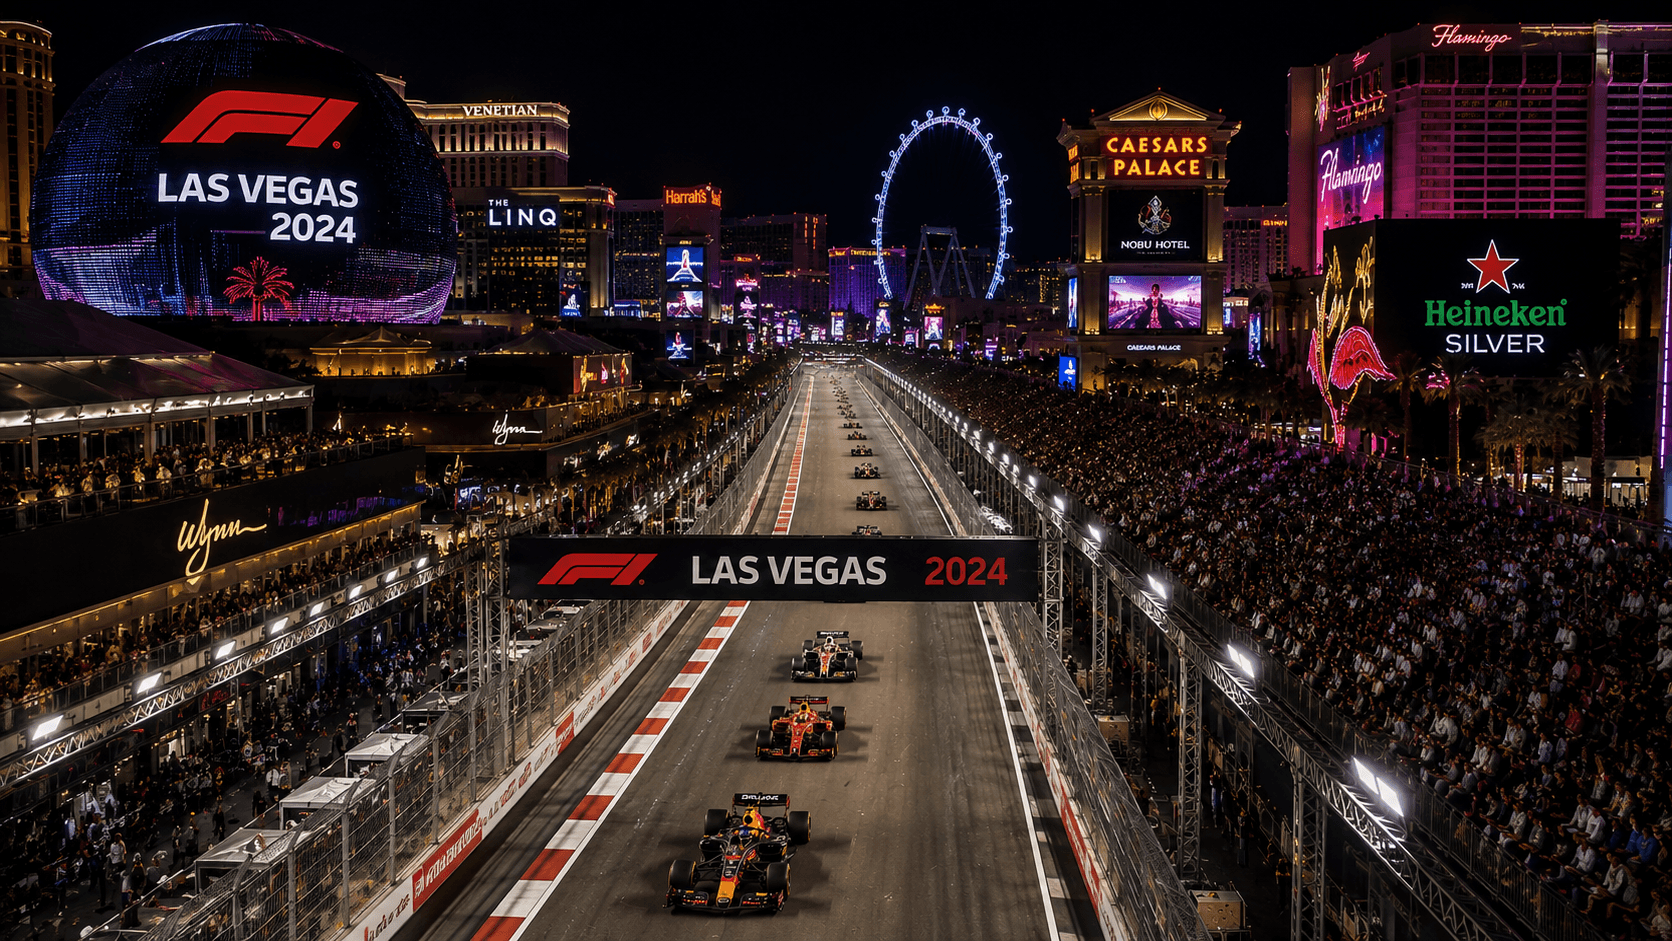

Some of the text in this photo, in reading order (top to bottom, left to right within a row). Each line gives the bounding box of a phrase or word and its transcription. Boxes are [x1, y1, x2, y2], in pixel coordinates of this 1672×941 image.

[1432, 24, 1512, 51] Flamingo
[462, 104, 538, 116] VENETIAN
[1106, 136, 1208, 153] CAESARS
[1113, 158, 1201, 176] PALACE
[1320, 147, 1382, 204] Flamingo
[158, 172, 359, 209] LAS VEGAS
[665, 188, 708, 205] Harrah's
[488, 199, 509, 207] THE
[488, 208, 557, 226] LINQ
[269, 212, 357, 244] 2024
[1120, 240, 1191, 249] NOBU HOTEL
[1424, 299, 1567, 327] Heineken
[1445, 333, 1546, 354] SILVER
[692, 555, 1009, 586] LAS VEGAS 2024
